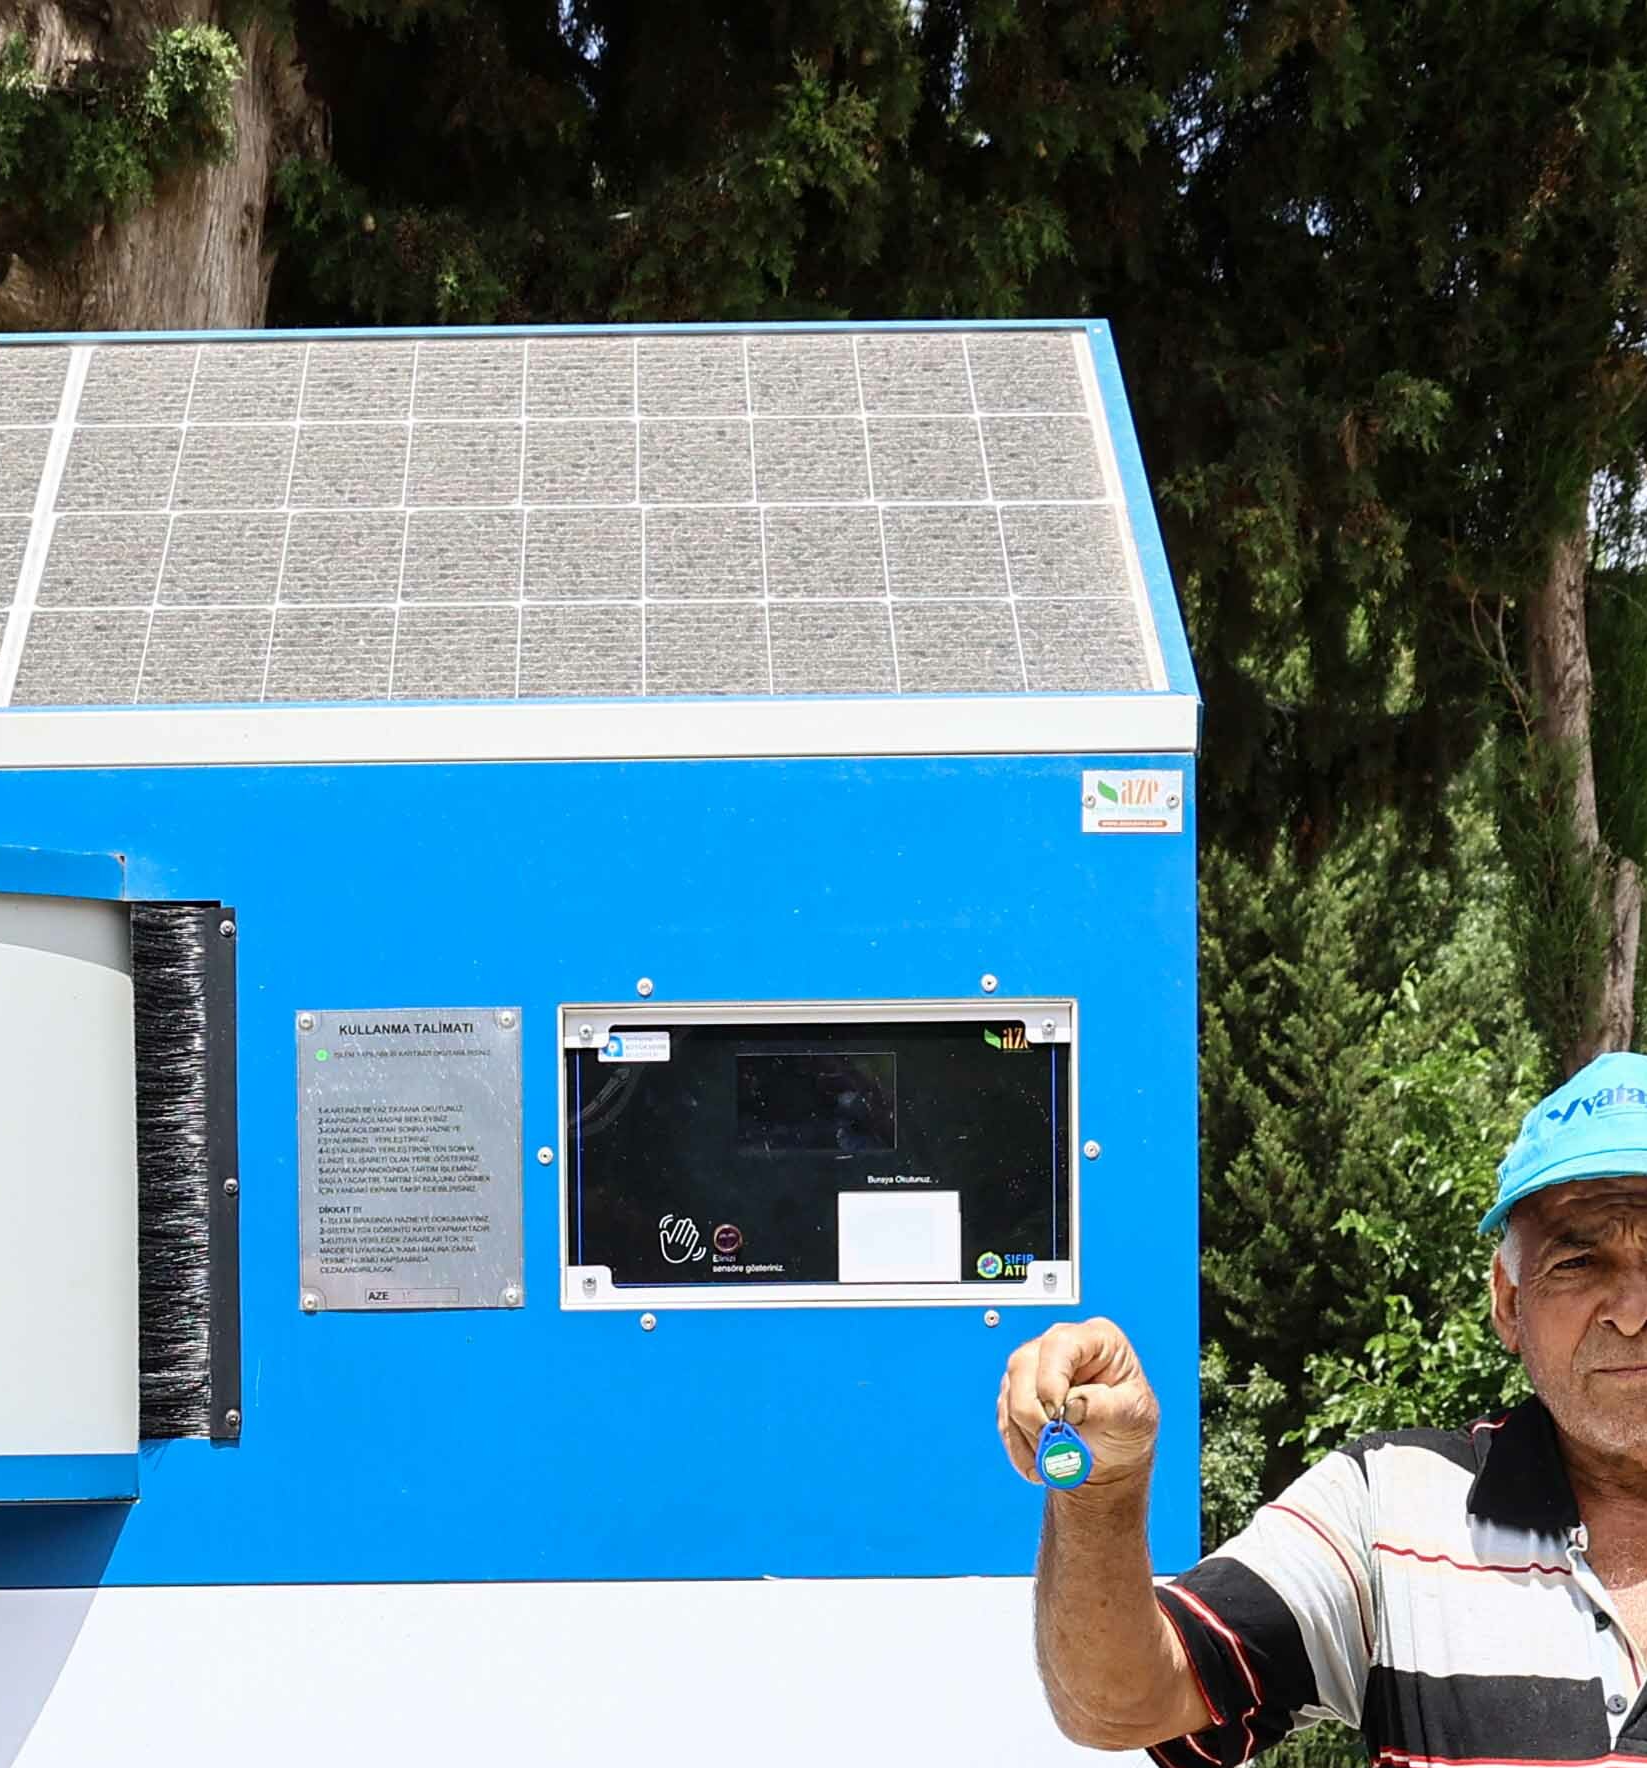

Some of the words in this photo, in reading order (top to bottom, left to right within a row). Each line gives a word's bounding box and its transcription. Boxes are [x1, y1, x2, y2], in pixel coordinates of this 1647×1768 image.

[339, 1024, 411, 1035] KULLANMA
[414, 1021, 474, 1034] TALİMATI
[319, 1205, 351, 1214] DİKKAT
[1004, 1265, 1027, 1277] ATI
[368, 1291, 389, 1301] AZE
